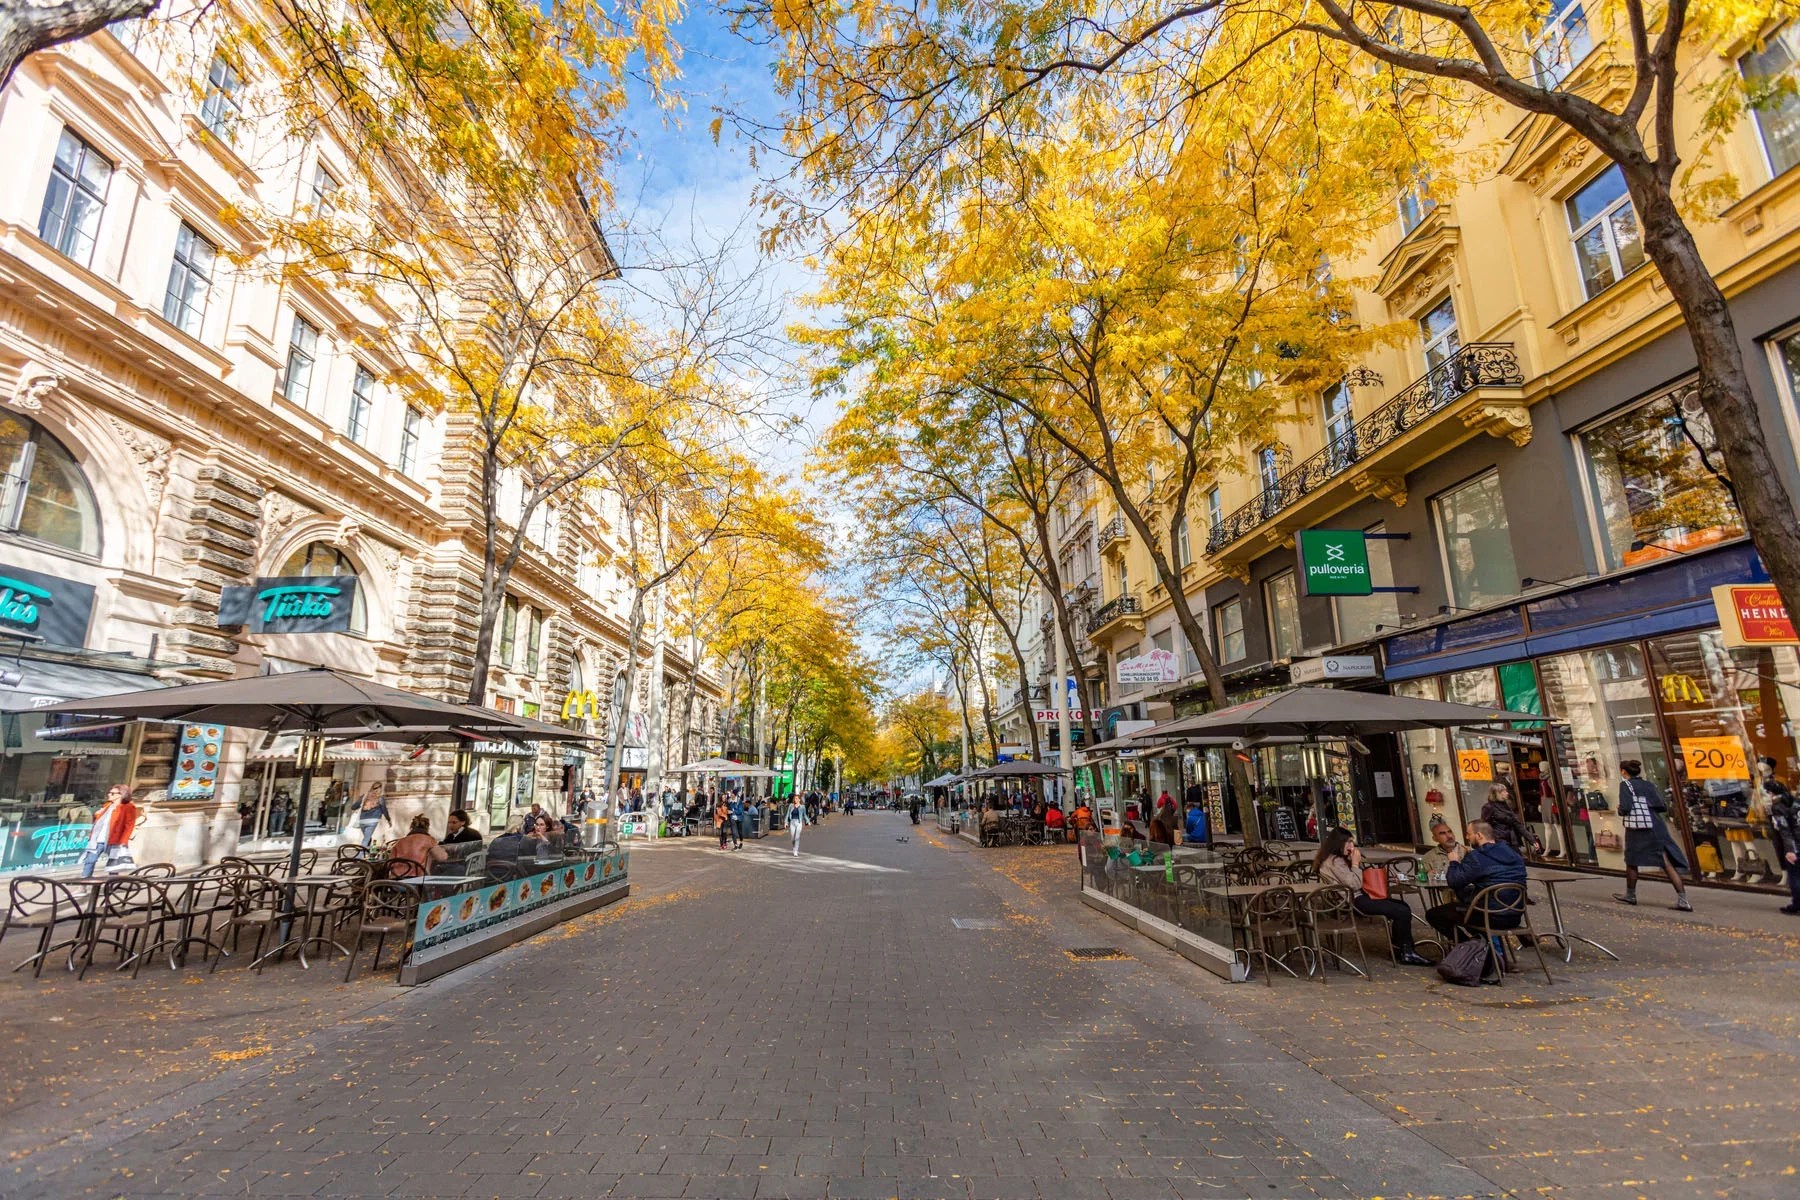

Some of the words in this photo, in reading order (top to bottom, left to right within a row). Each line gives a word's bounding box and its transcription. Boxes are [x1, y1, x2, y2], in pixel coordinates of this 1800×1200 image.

[1309, 563, 1364, 576] pulloveria
[258, 585, 341, 622] Türkis
[1740, 608, 1789, 619] HEIND
